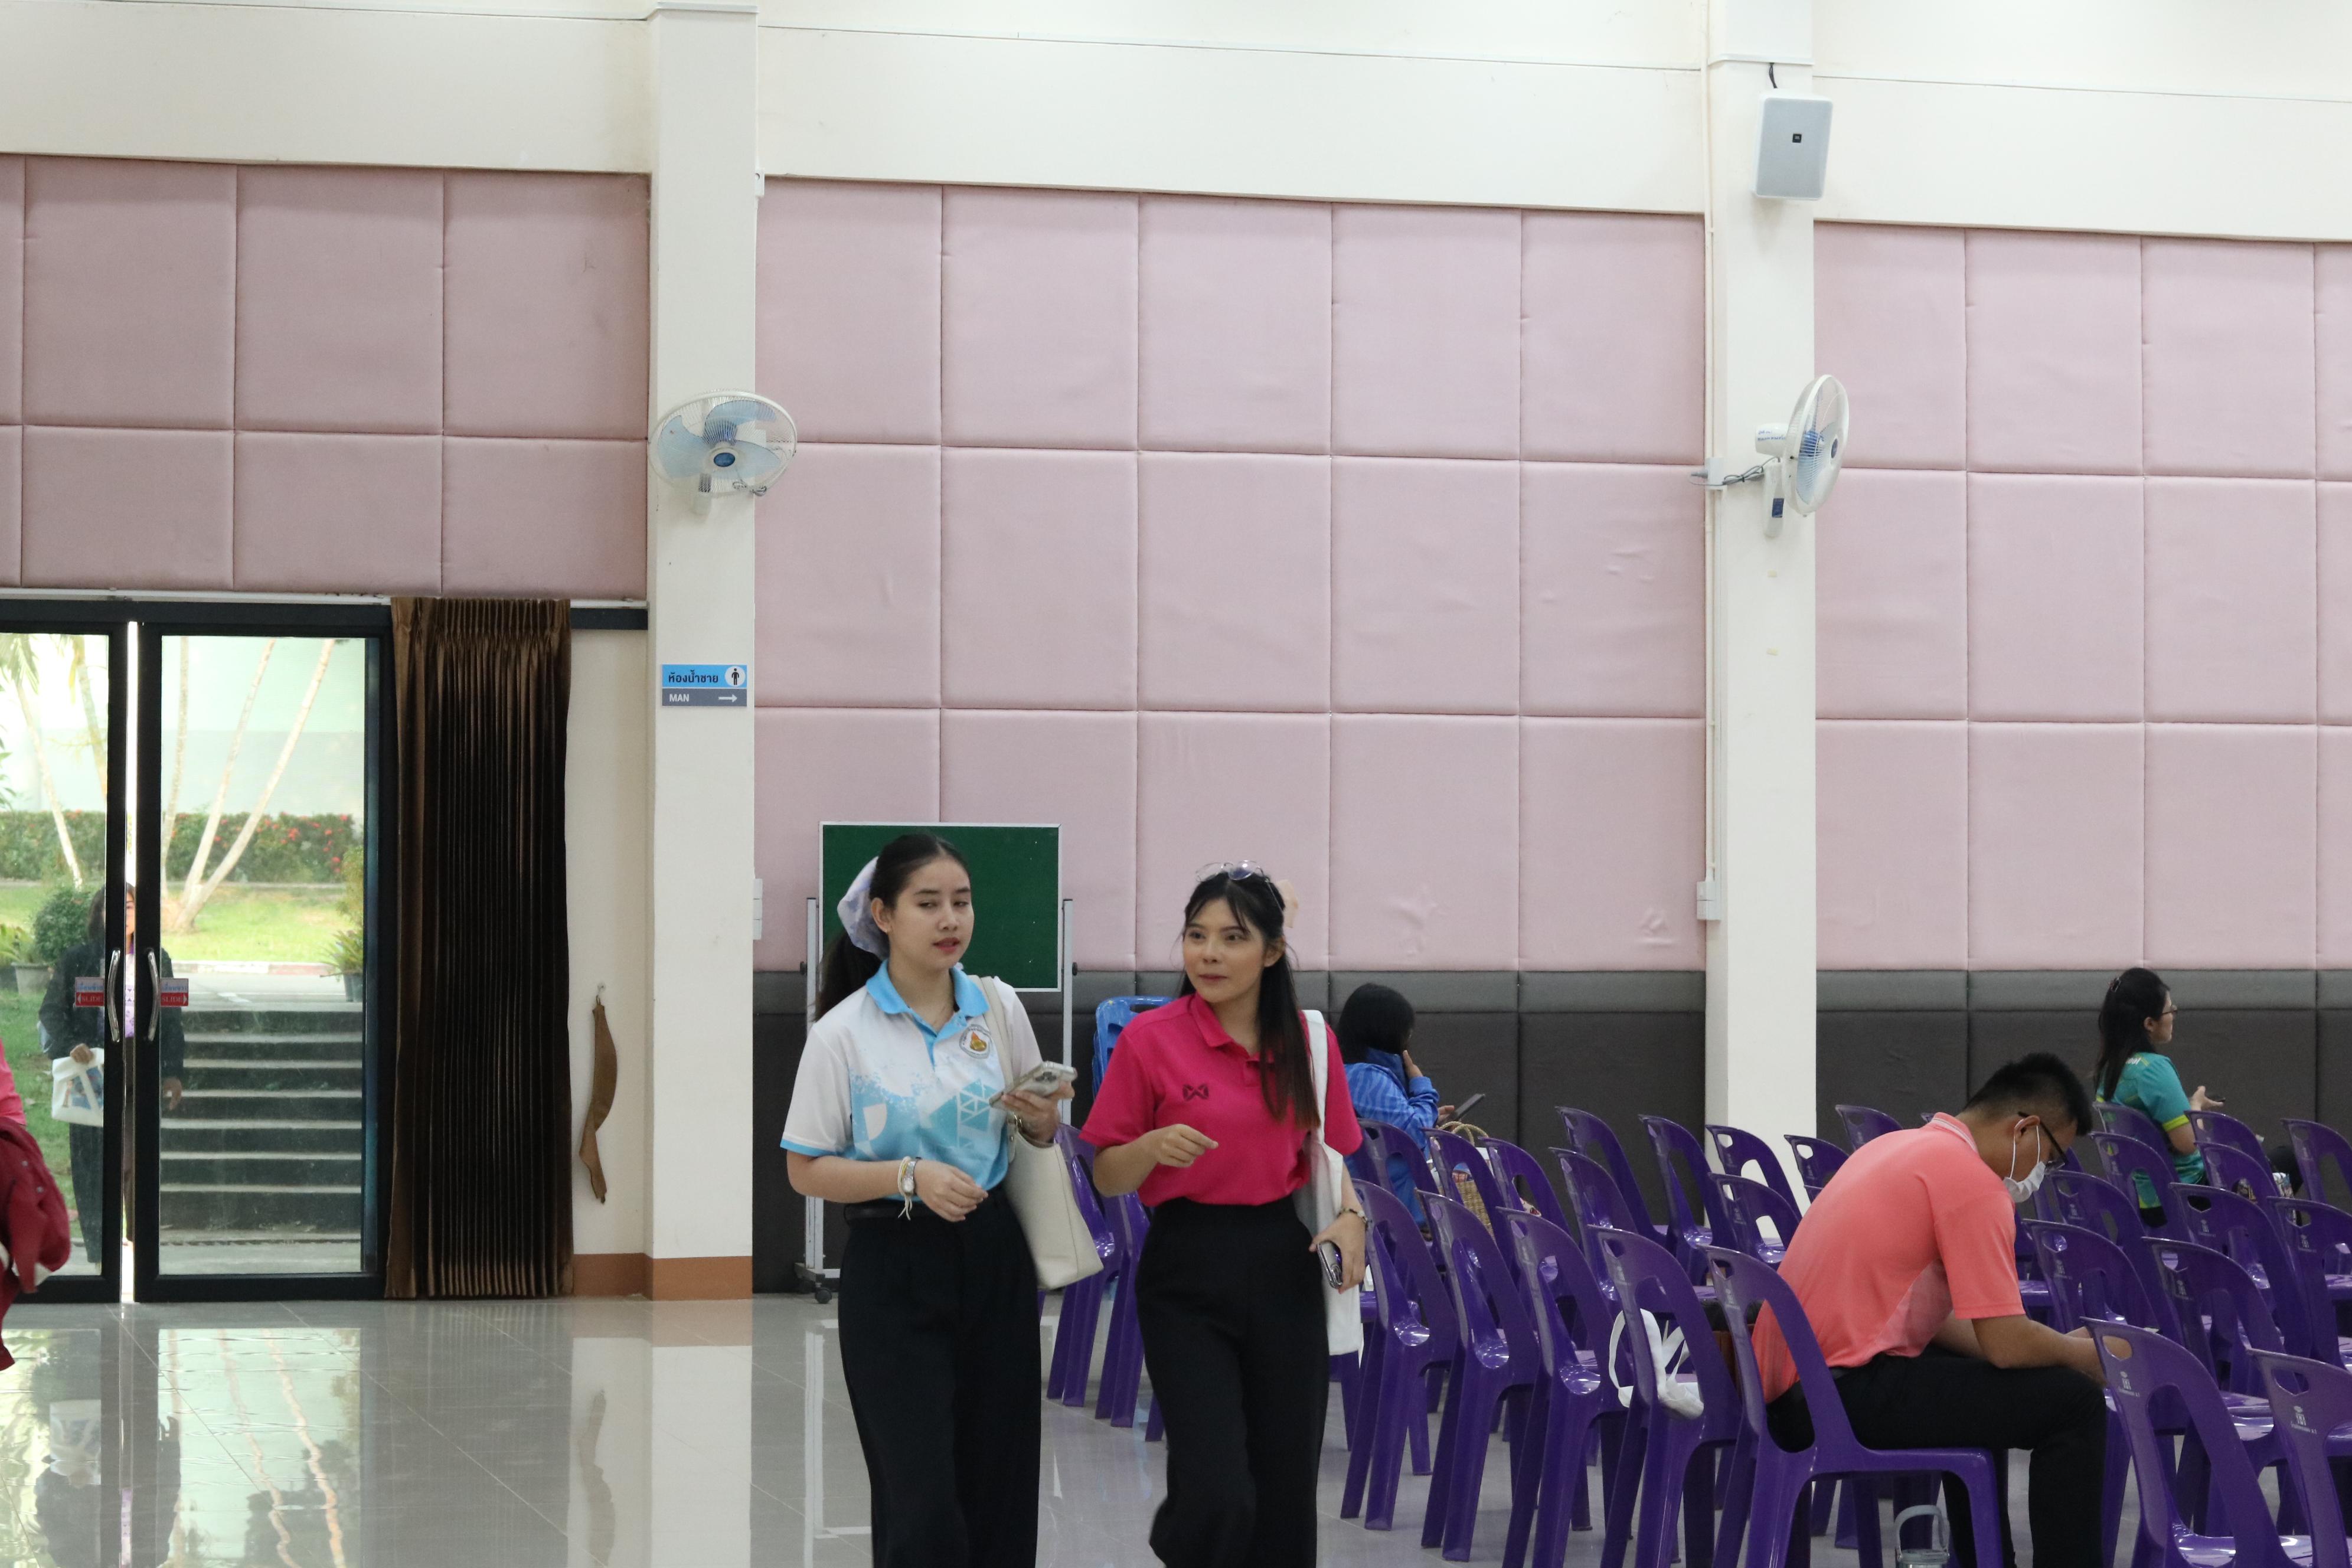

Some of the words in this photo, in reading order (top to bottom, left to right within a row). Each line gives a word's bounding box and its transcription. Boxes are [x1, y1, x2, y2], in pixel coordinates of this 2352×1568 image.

[668, 669, 718, 683] ห้องน้ำชาย
[669, 694, 690, 702] MAN
